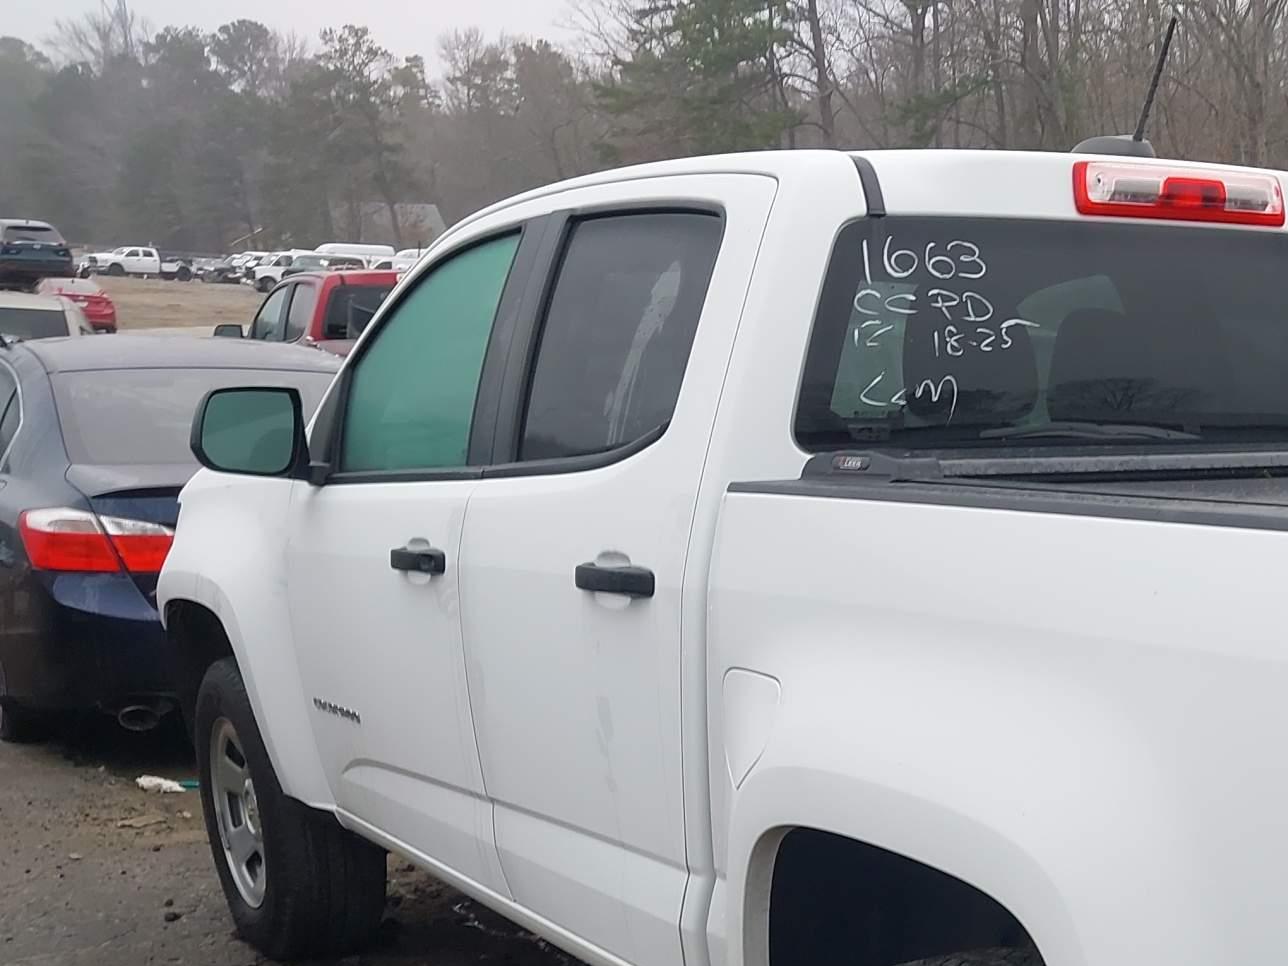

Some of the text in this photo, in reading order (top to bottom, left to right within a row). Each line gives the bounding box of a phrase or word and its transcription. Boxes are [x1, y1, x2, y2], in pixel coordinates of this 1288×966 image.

[862, 236, 986, 284] 1663
[928, 288, 993, 320] PD
[933, 319, 1040, 356] 18-25
